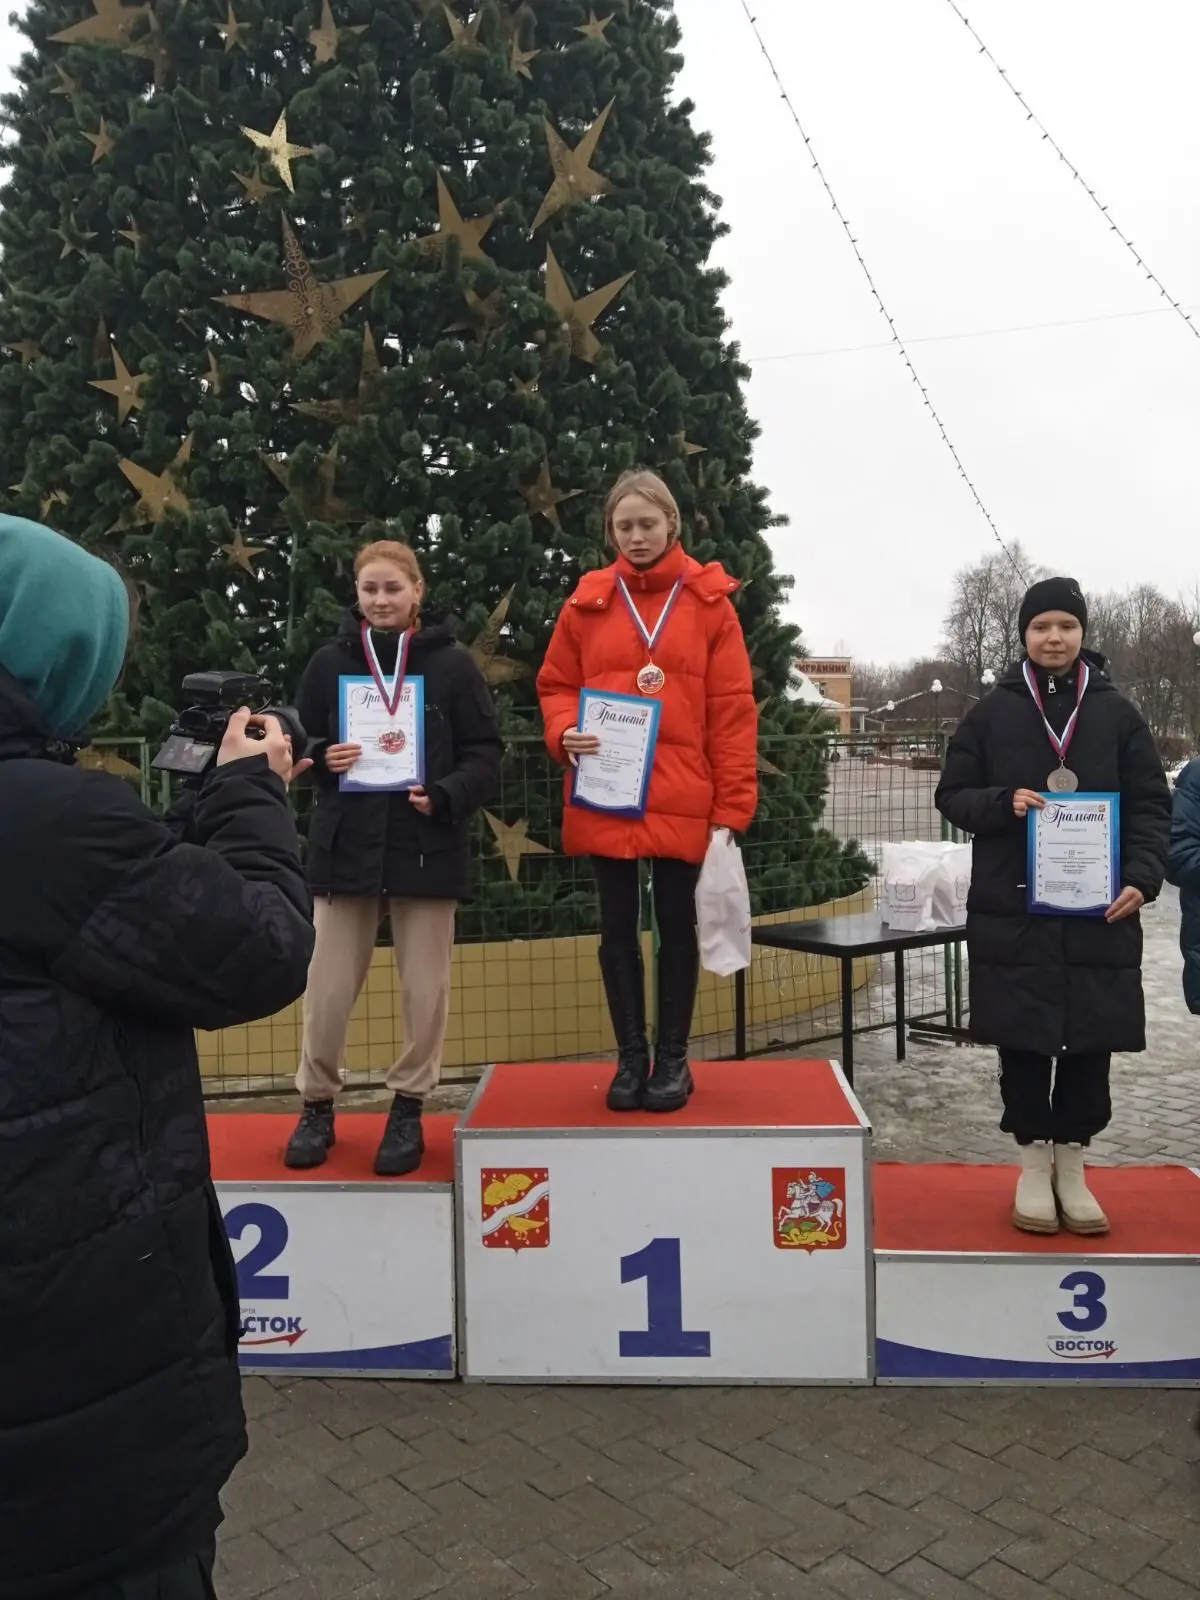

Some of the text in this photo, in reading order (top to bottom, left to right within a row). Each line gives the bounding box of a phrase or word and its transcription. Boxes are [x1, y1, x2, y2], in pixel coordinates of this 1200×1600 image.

[588, 701, 646, 726] Грамота
[1041, 803, 1105, 828] Грамота
[223, 1202, 290, 1300] 2
[619, 1237, 712, 1358] 1
[1056, 1270, 1108, 1333] 3
[240, 1316, 302, 1333] СТОК
[1056, 1340, 1115, 1351] ВОСТОК
